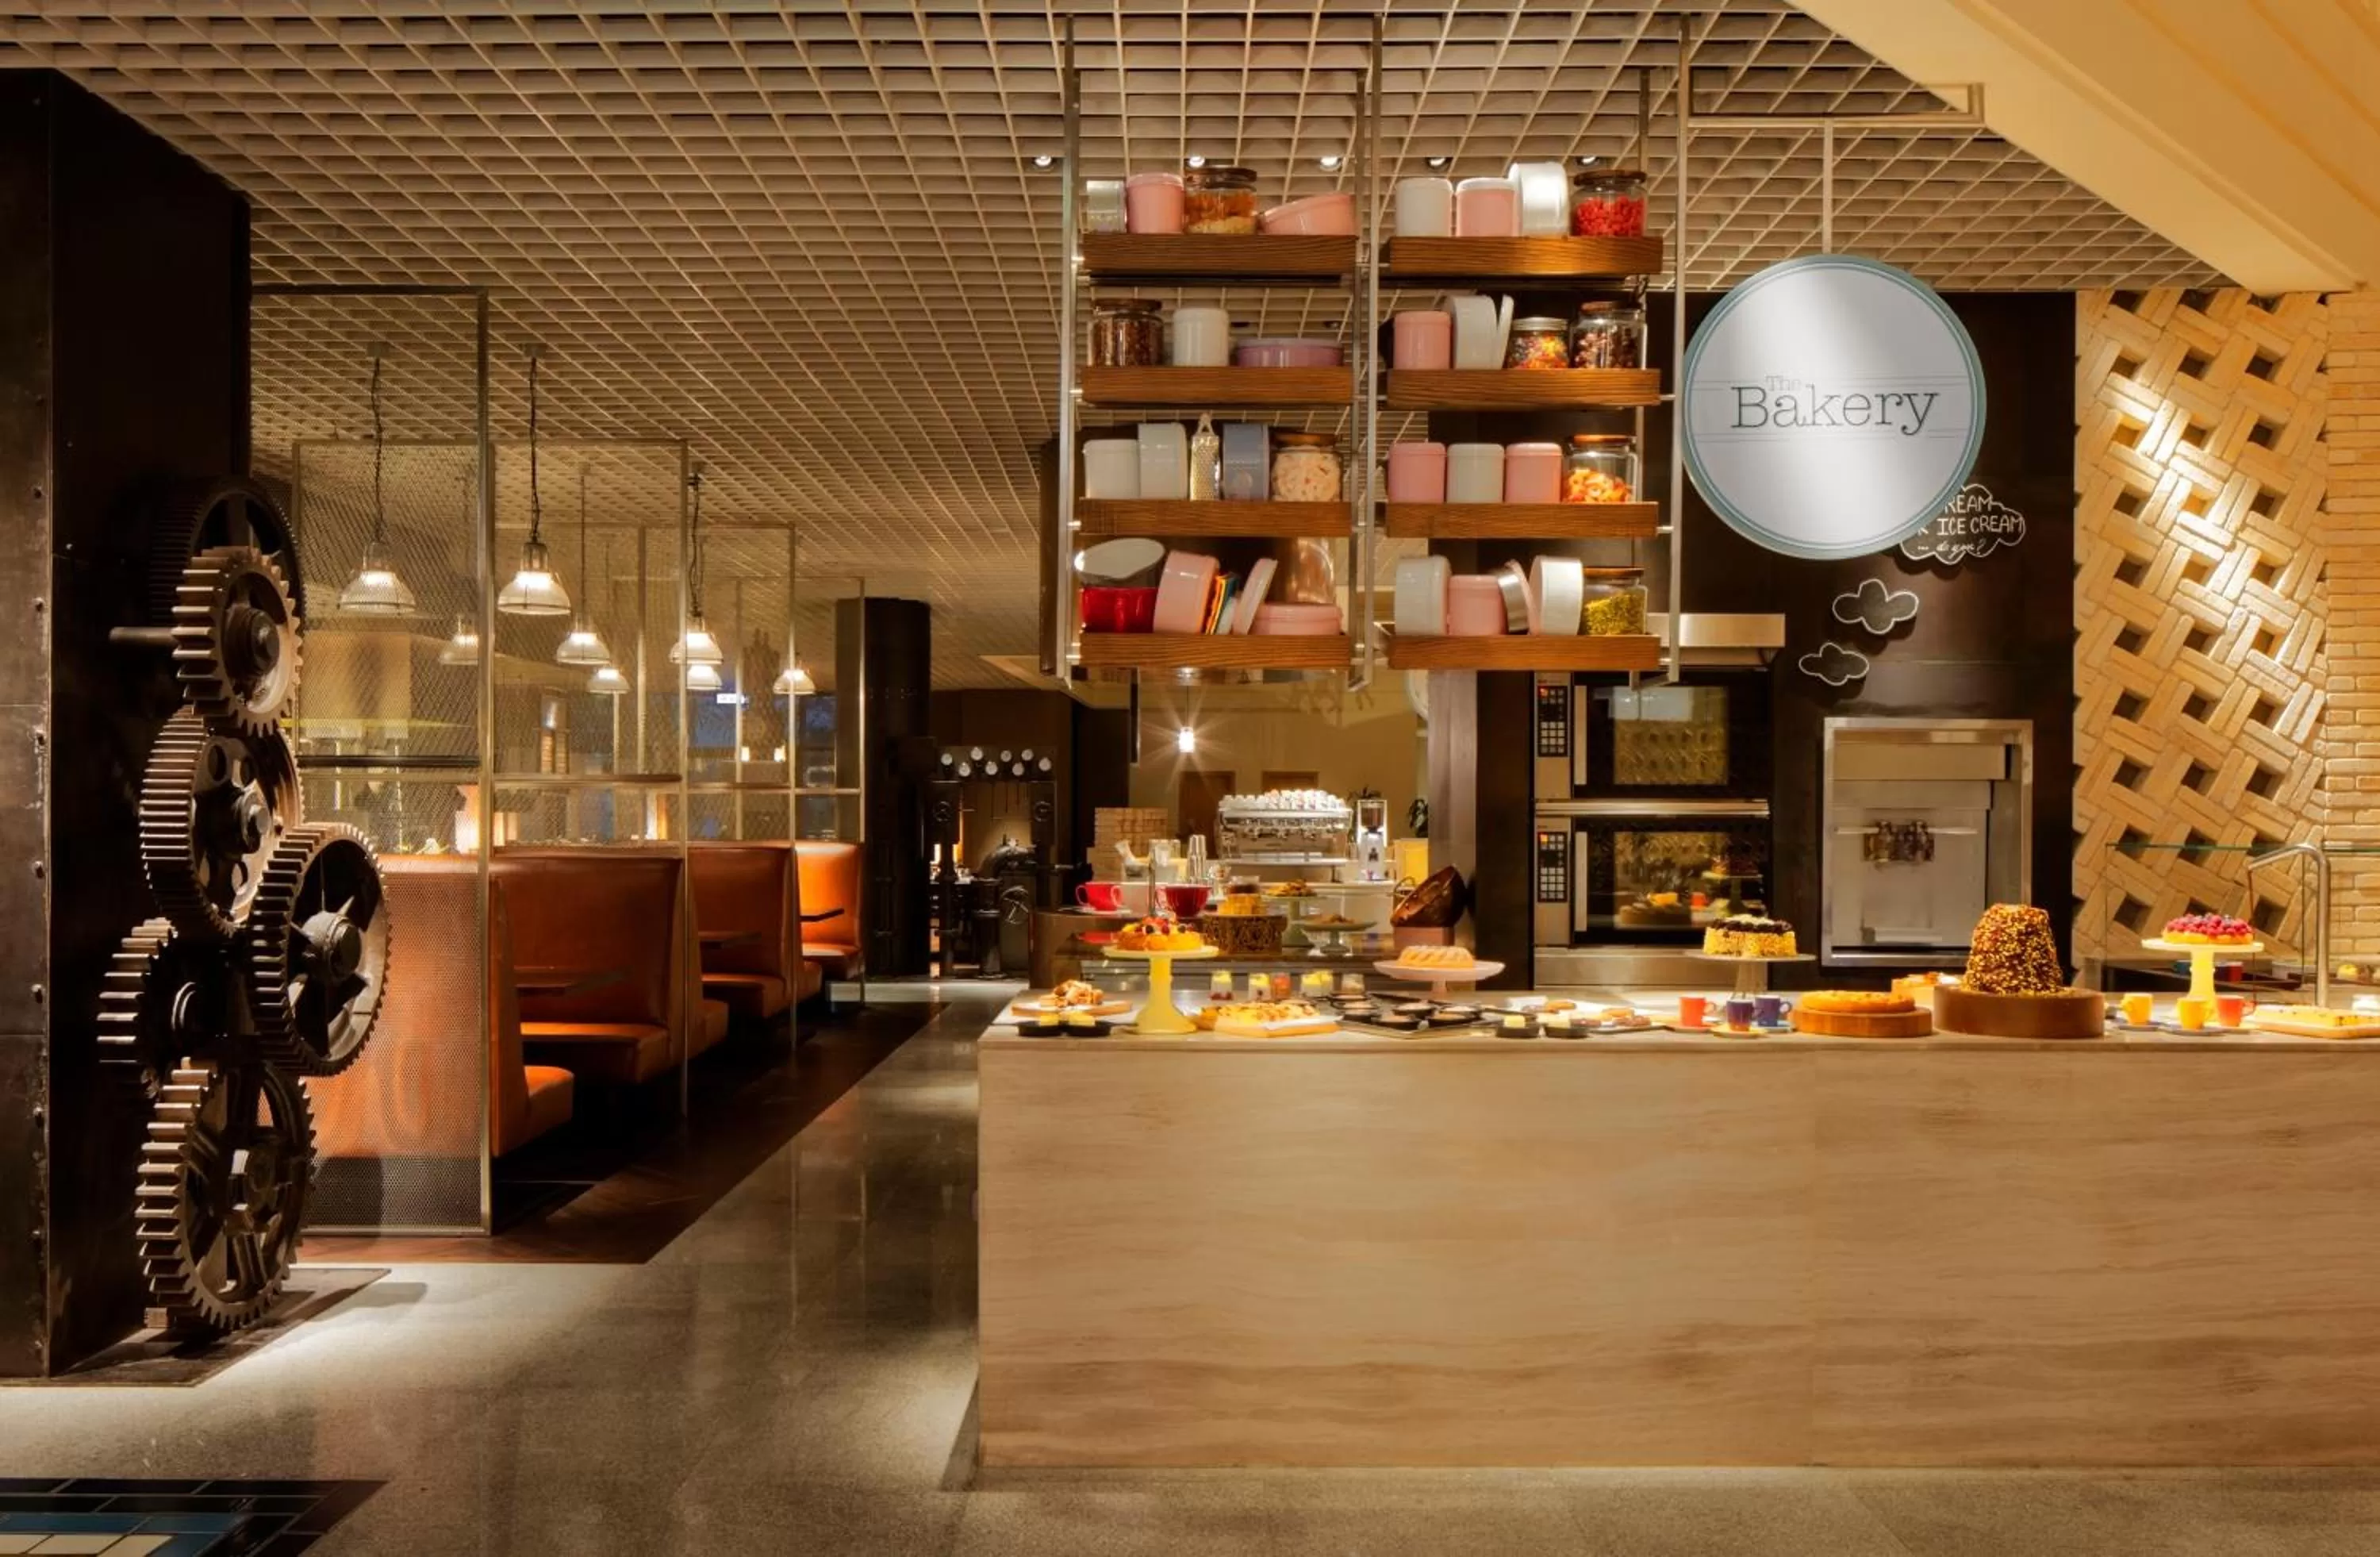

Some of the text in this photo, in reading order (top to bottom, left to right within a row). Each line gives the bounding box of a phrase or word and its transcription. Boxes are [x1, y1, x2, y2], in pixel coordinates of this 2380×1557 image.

[1730, 383, 1940, 436] Bakery
[1937, 516, 1967, 536] ICE
[1970, 514, 2024, 534] CREAM
